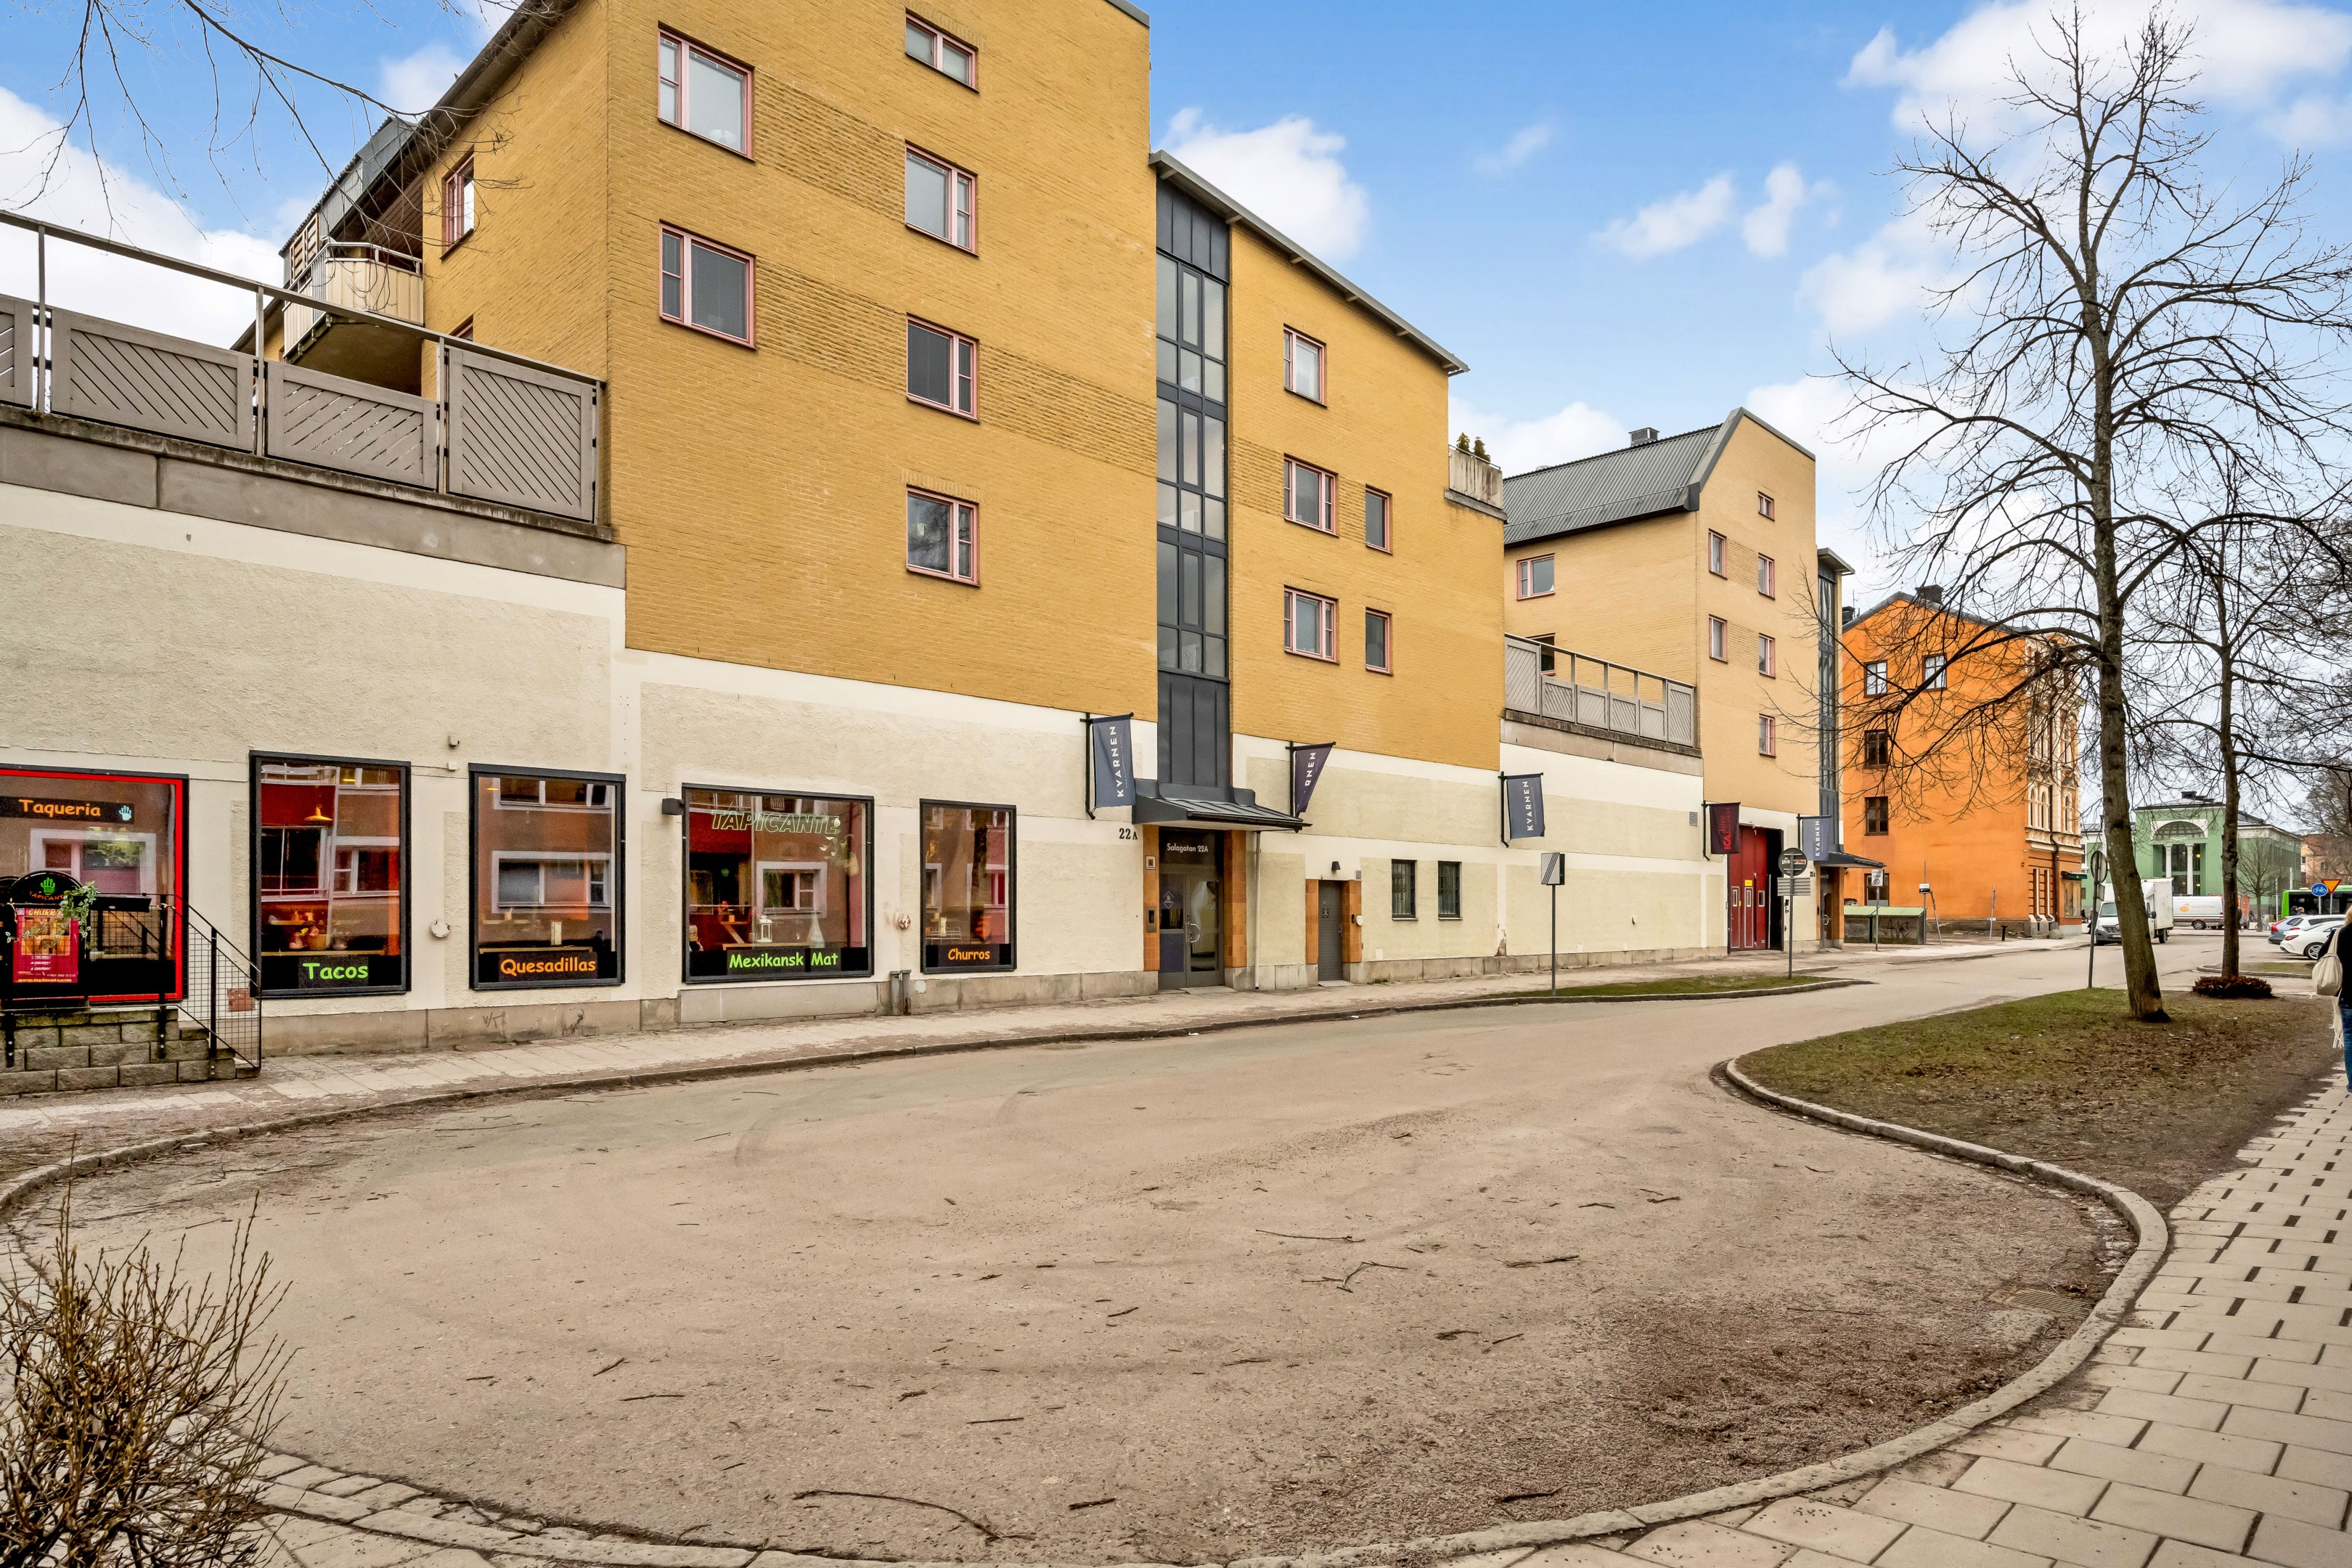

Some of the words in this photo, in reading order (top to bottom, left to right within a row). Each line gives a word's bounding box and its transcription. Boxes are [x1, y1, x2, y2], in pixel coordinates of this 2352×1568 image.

[1109, 726, 1124, 798] KVARNEN
[1304, 752, 1316, 786] RNEN
[18, 799, 101, 817] Taqueria
[1522, 780, 1533, 831] KVARNEN
[711, 810, 839, 834] TAPICANTE
[1167, 843, 1196, 853] Salagatan
[1723, 834, 1731, 849] ICA
[30, 891, 63, 901] APICANT
[729, 952, 804, 968] Mexikansk
[811, 952, 838, 965] Mat
[947, 948, 990, 960] Churros
[302, 963, 368, 979] Tacos
[500, 957, 596, 976] Quesadillas
